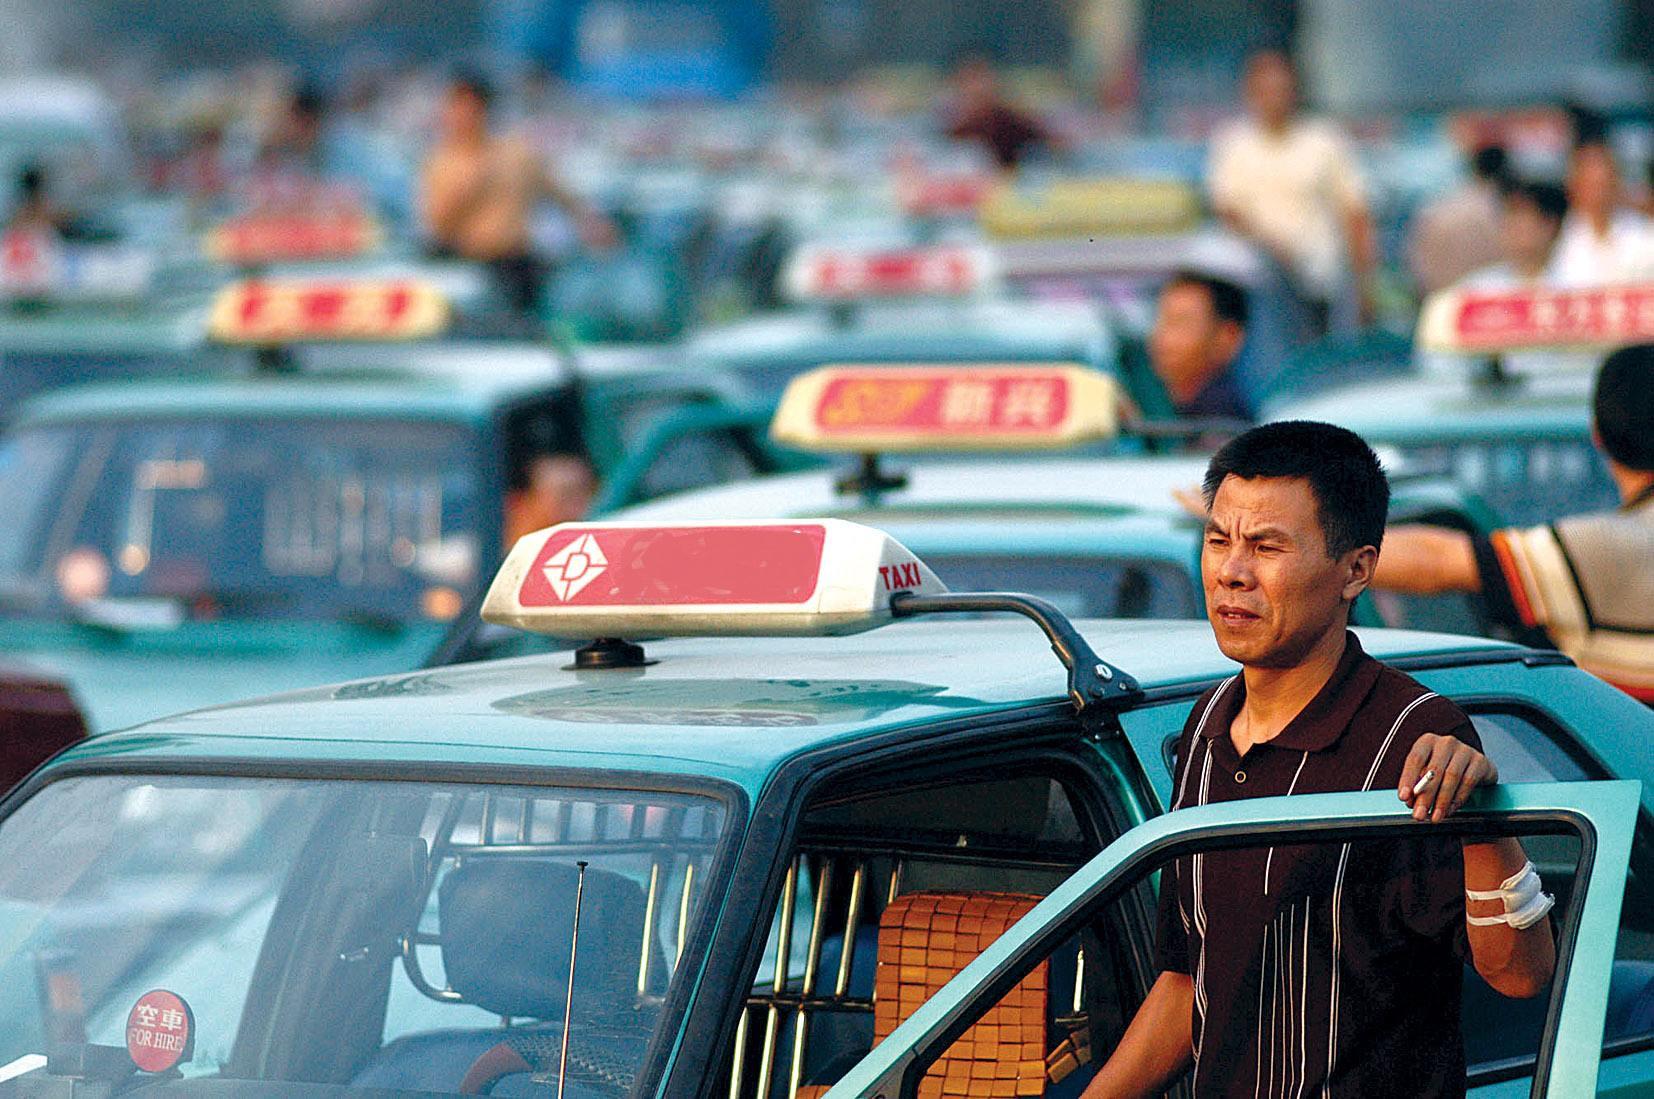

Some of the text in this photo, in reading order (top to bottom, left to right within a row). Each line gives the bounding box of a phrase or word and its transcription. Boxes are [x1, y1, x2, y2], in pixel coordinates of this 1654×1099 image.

[879, 562, 922, 591] TAXI
[136, 1003, 184, 1031] 空車
[127, 1028, 183, 1051] FOR HIRE
